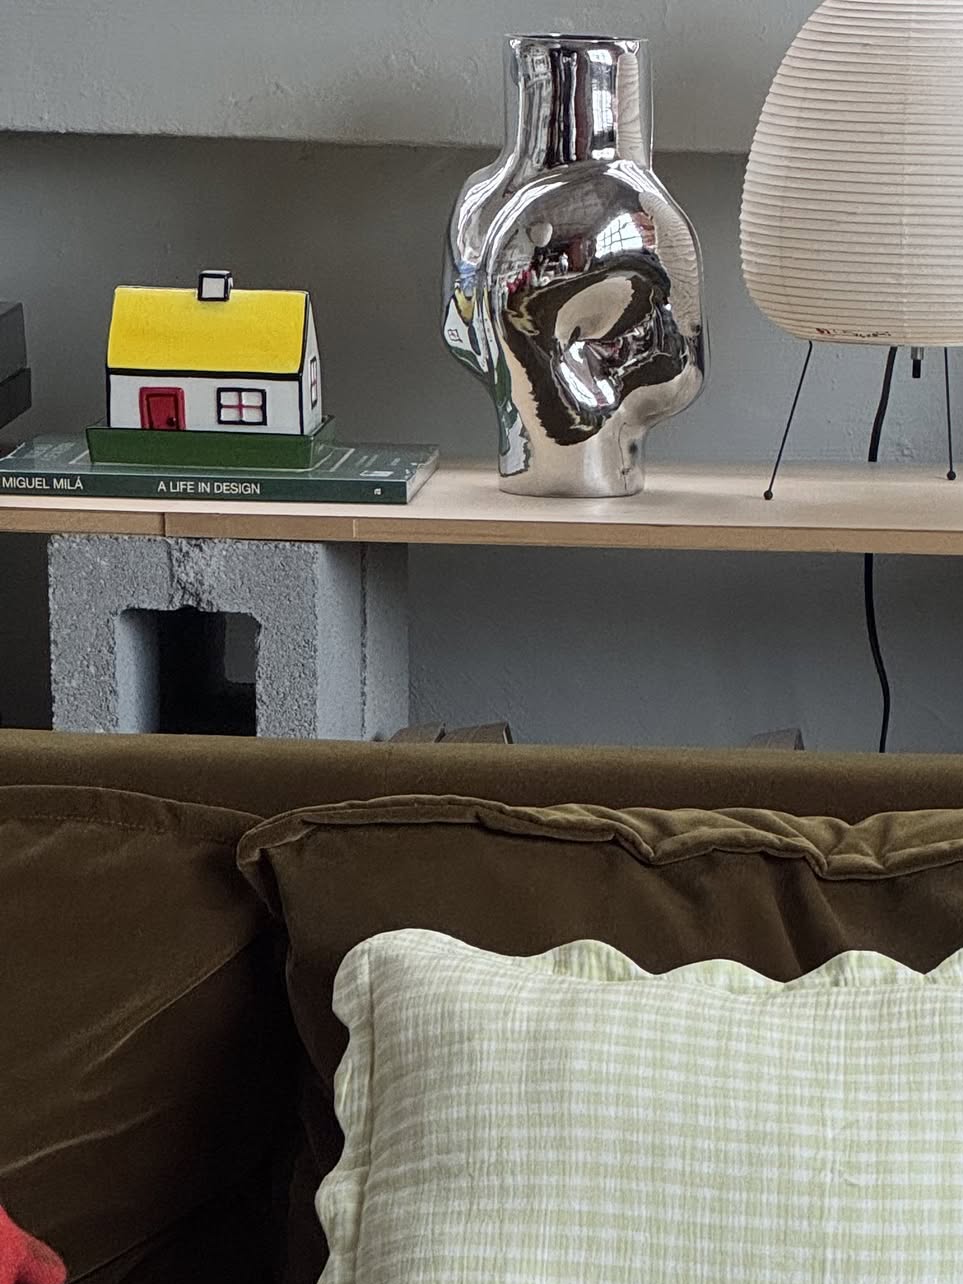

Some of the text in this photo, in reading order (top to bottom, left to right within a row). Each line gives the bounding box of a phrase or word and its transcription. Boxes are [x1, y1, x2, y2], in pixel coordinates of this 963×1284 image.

[2, 475, 84, 490] MIGUEL MILÁ
[157, 482, 261, 495] A LIFE IN DESIGN
